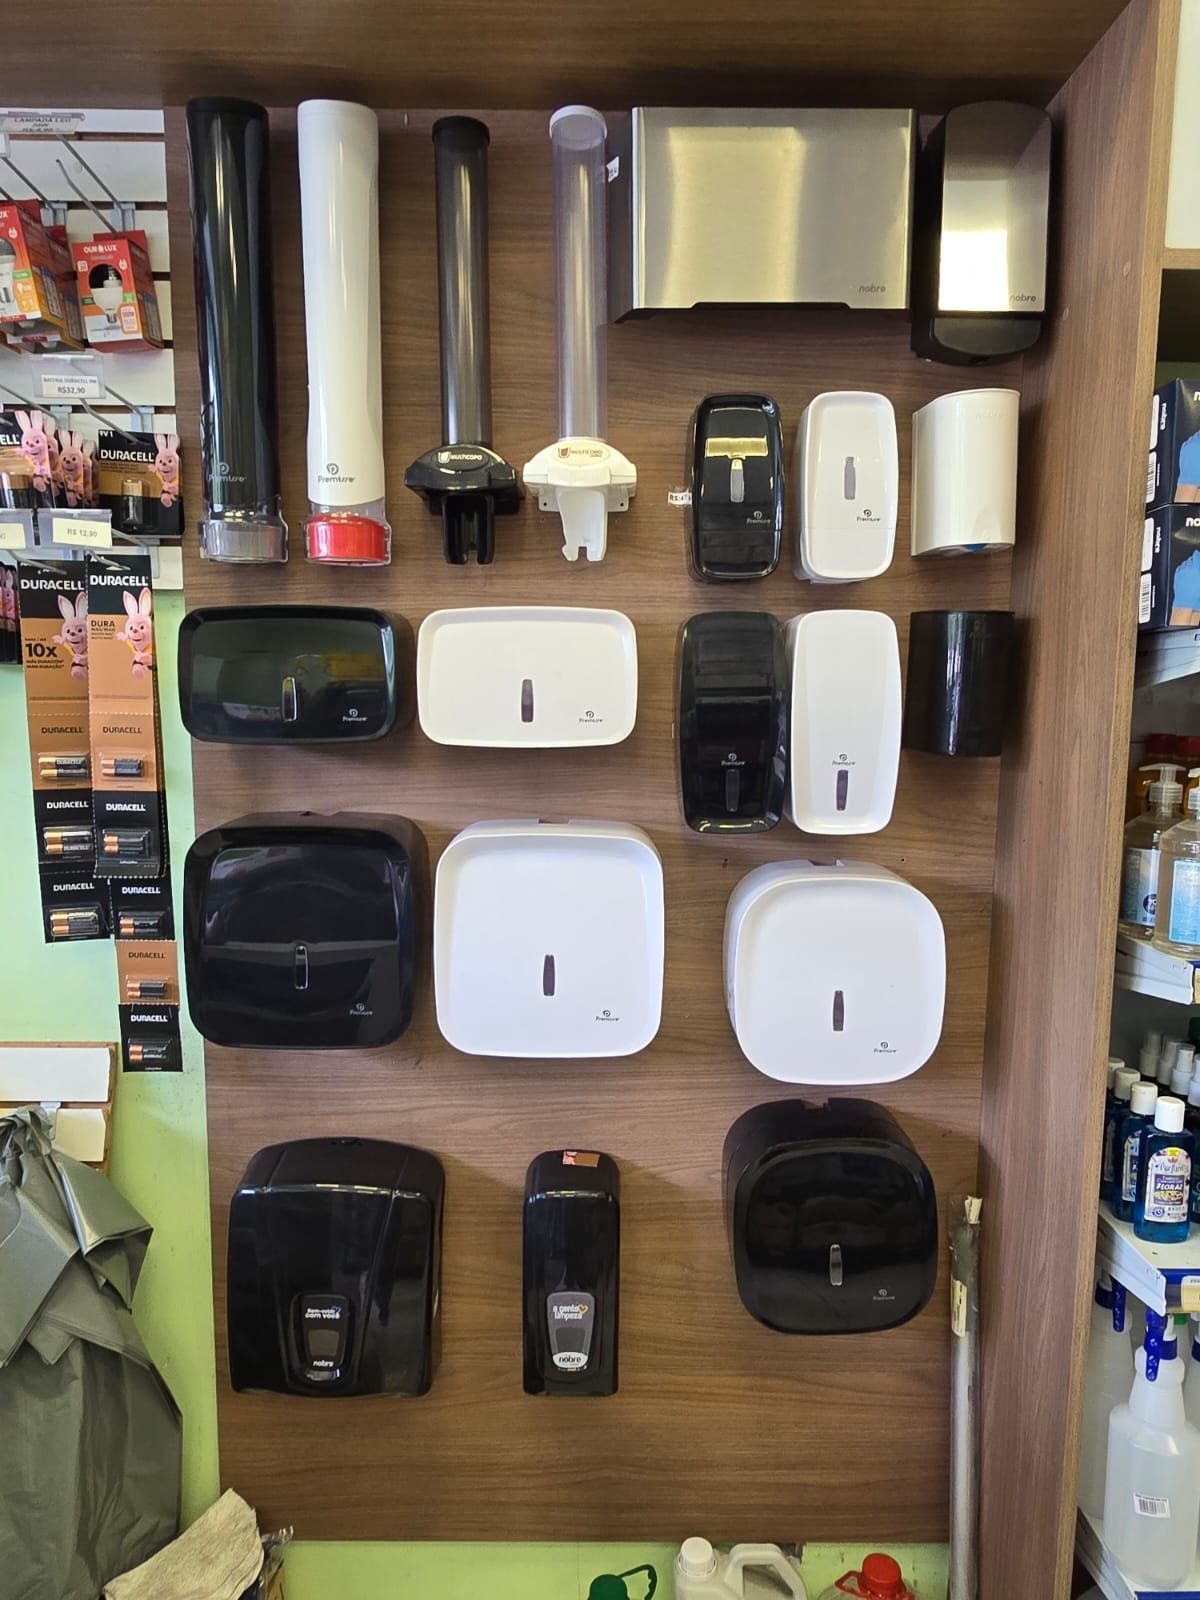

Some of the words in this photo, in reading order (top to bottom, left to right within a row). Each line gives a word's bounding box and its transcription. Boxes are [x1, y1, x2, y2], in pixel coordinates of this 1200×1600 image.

[858, 283, 886, 293] nobre
[1009, 293, 1037, 302] nobre
[100, 449, 154, 462] DURACELL
[450, 454, 483, 462] MULTICOPO
[20, 579, 85, 590] DURACELL
[90, 575, 149, 587] DURACELL
[25, 643, 57, 657] 10x
[41, 726, 84, 734] DURACELL
[102, 726, 142, 734] DURACELL
[46, 801, 89, 809] DURACELL
[105, 803, 146, 811] DURACELL
[53, 883, 95, 891] DURACELL
[121, 886, 161, 894] DURACELL
[128, 951, 166, 959] DURACELL
[130, 1014, 168, 1022] DURACELL
[558, 1354, 582, 1363] nobre
